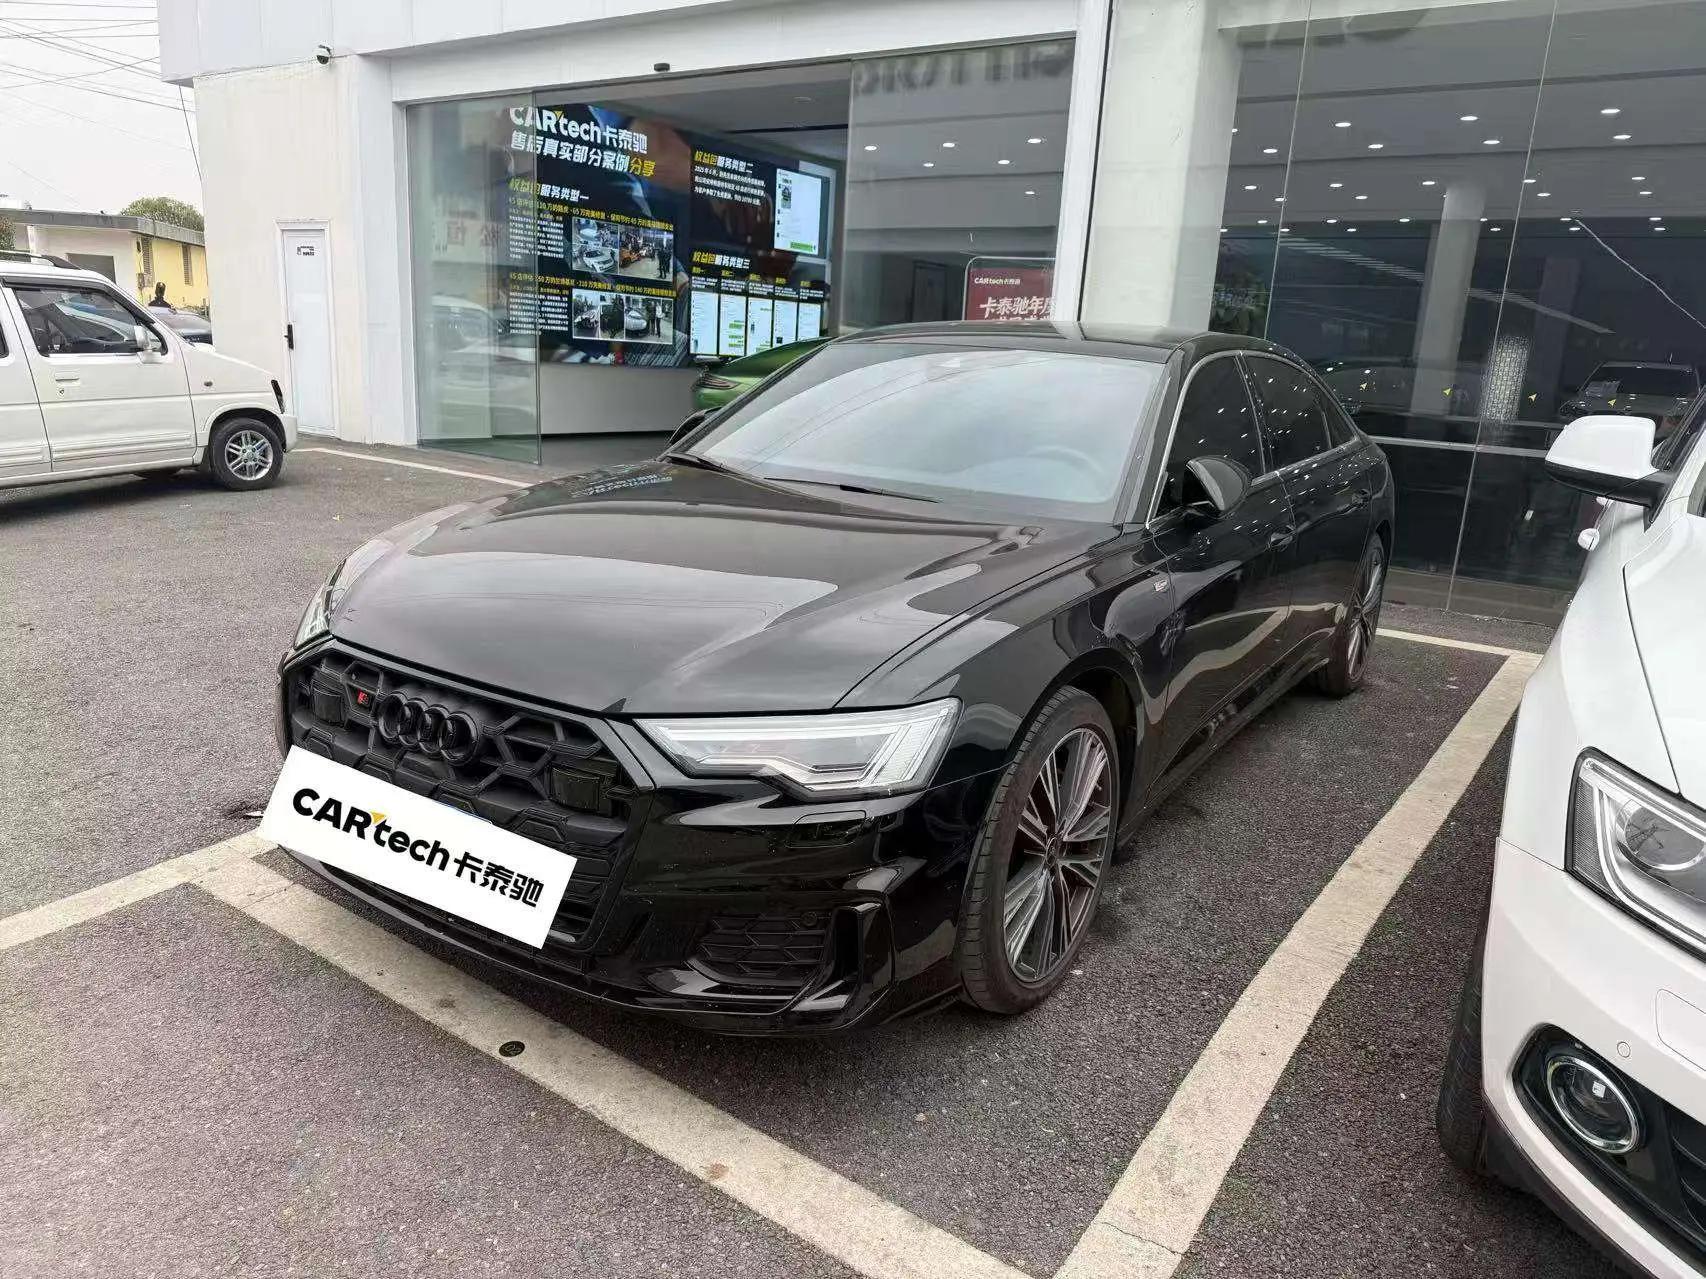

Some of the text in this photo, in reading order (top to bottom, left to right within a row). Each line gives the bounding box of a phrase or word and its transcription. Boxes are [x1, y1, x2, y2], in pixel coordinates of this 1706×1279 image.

[510, 106, 648, 154] CARtech 卡泰驰
